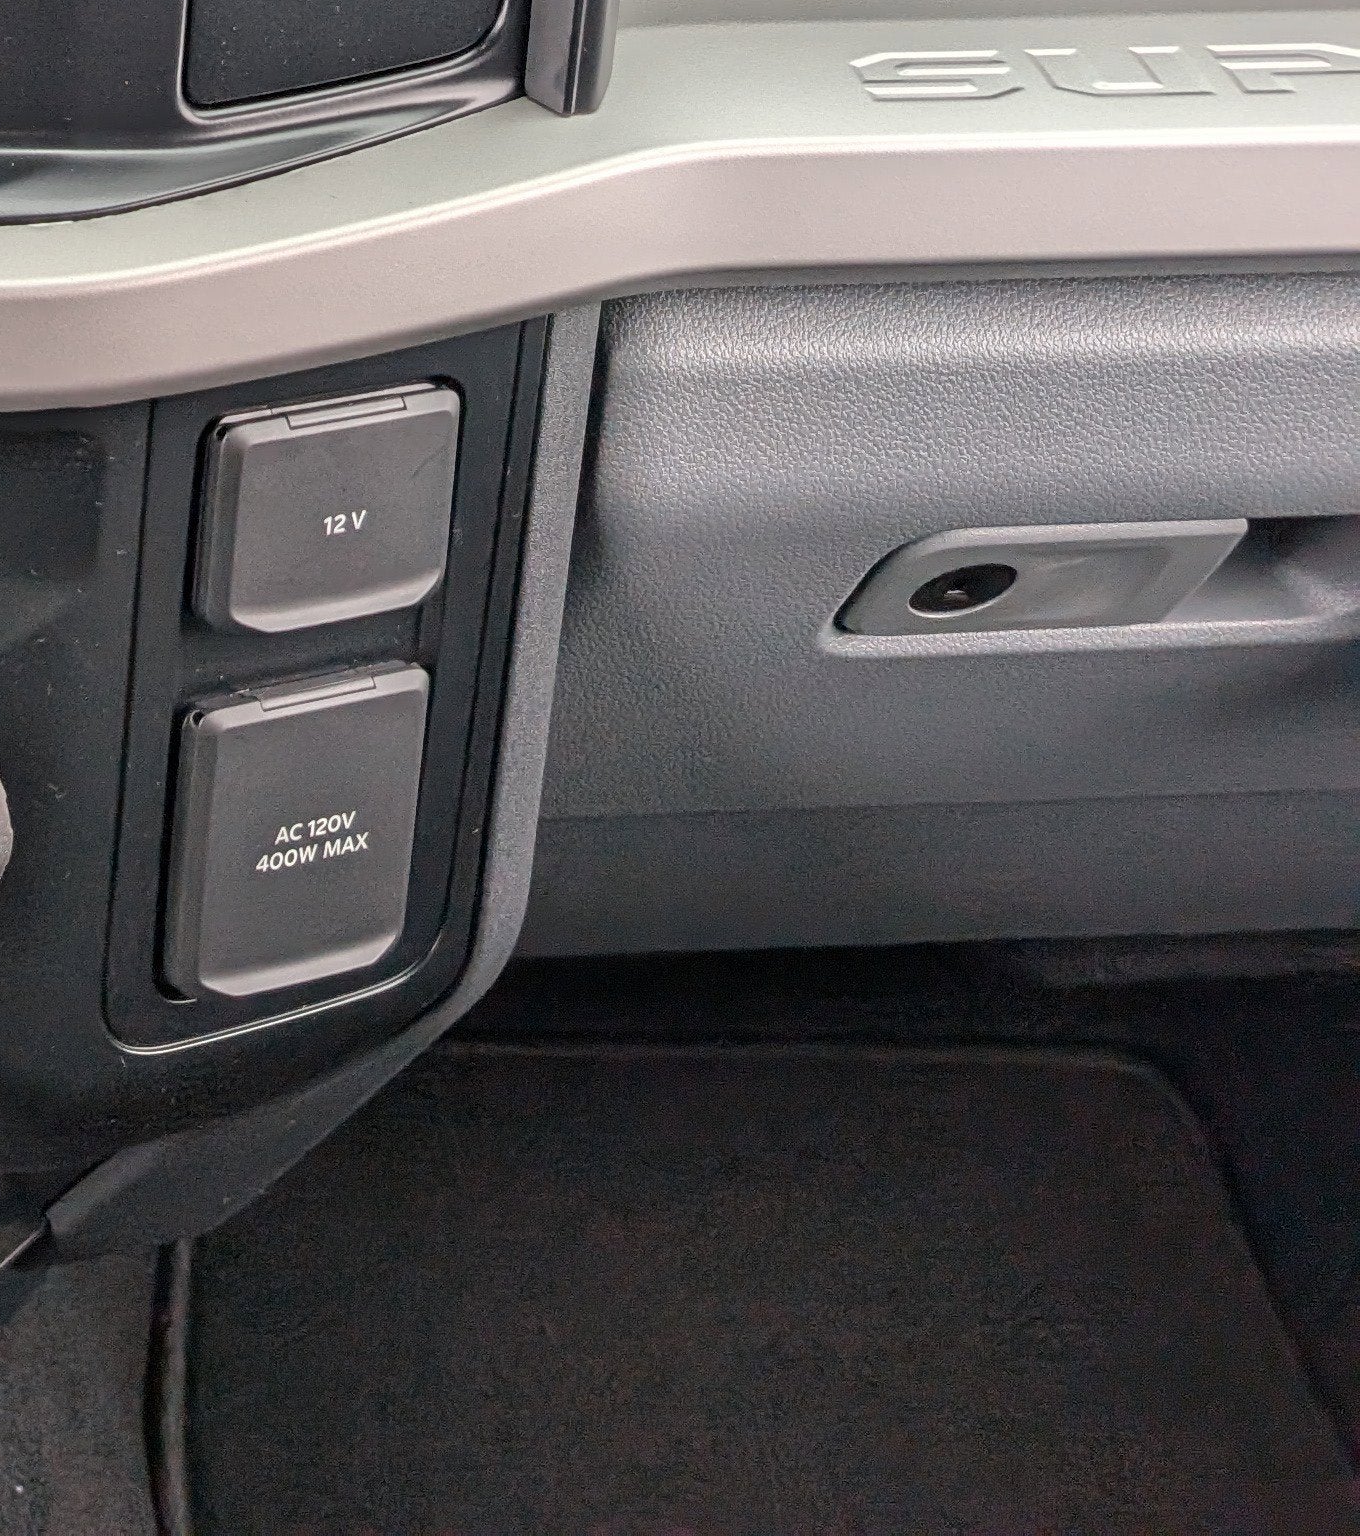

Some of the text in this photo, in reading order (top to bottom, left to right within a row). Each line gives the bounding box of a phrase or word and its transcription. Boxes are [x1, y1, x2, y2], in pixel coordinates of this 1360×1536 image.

[323, 510, 367, 536] 12 V
[275, 811, 356, 845] AC 120V
[256, 832, 369, 872] 400W MAX
